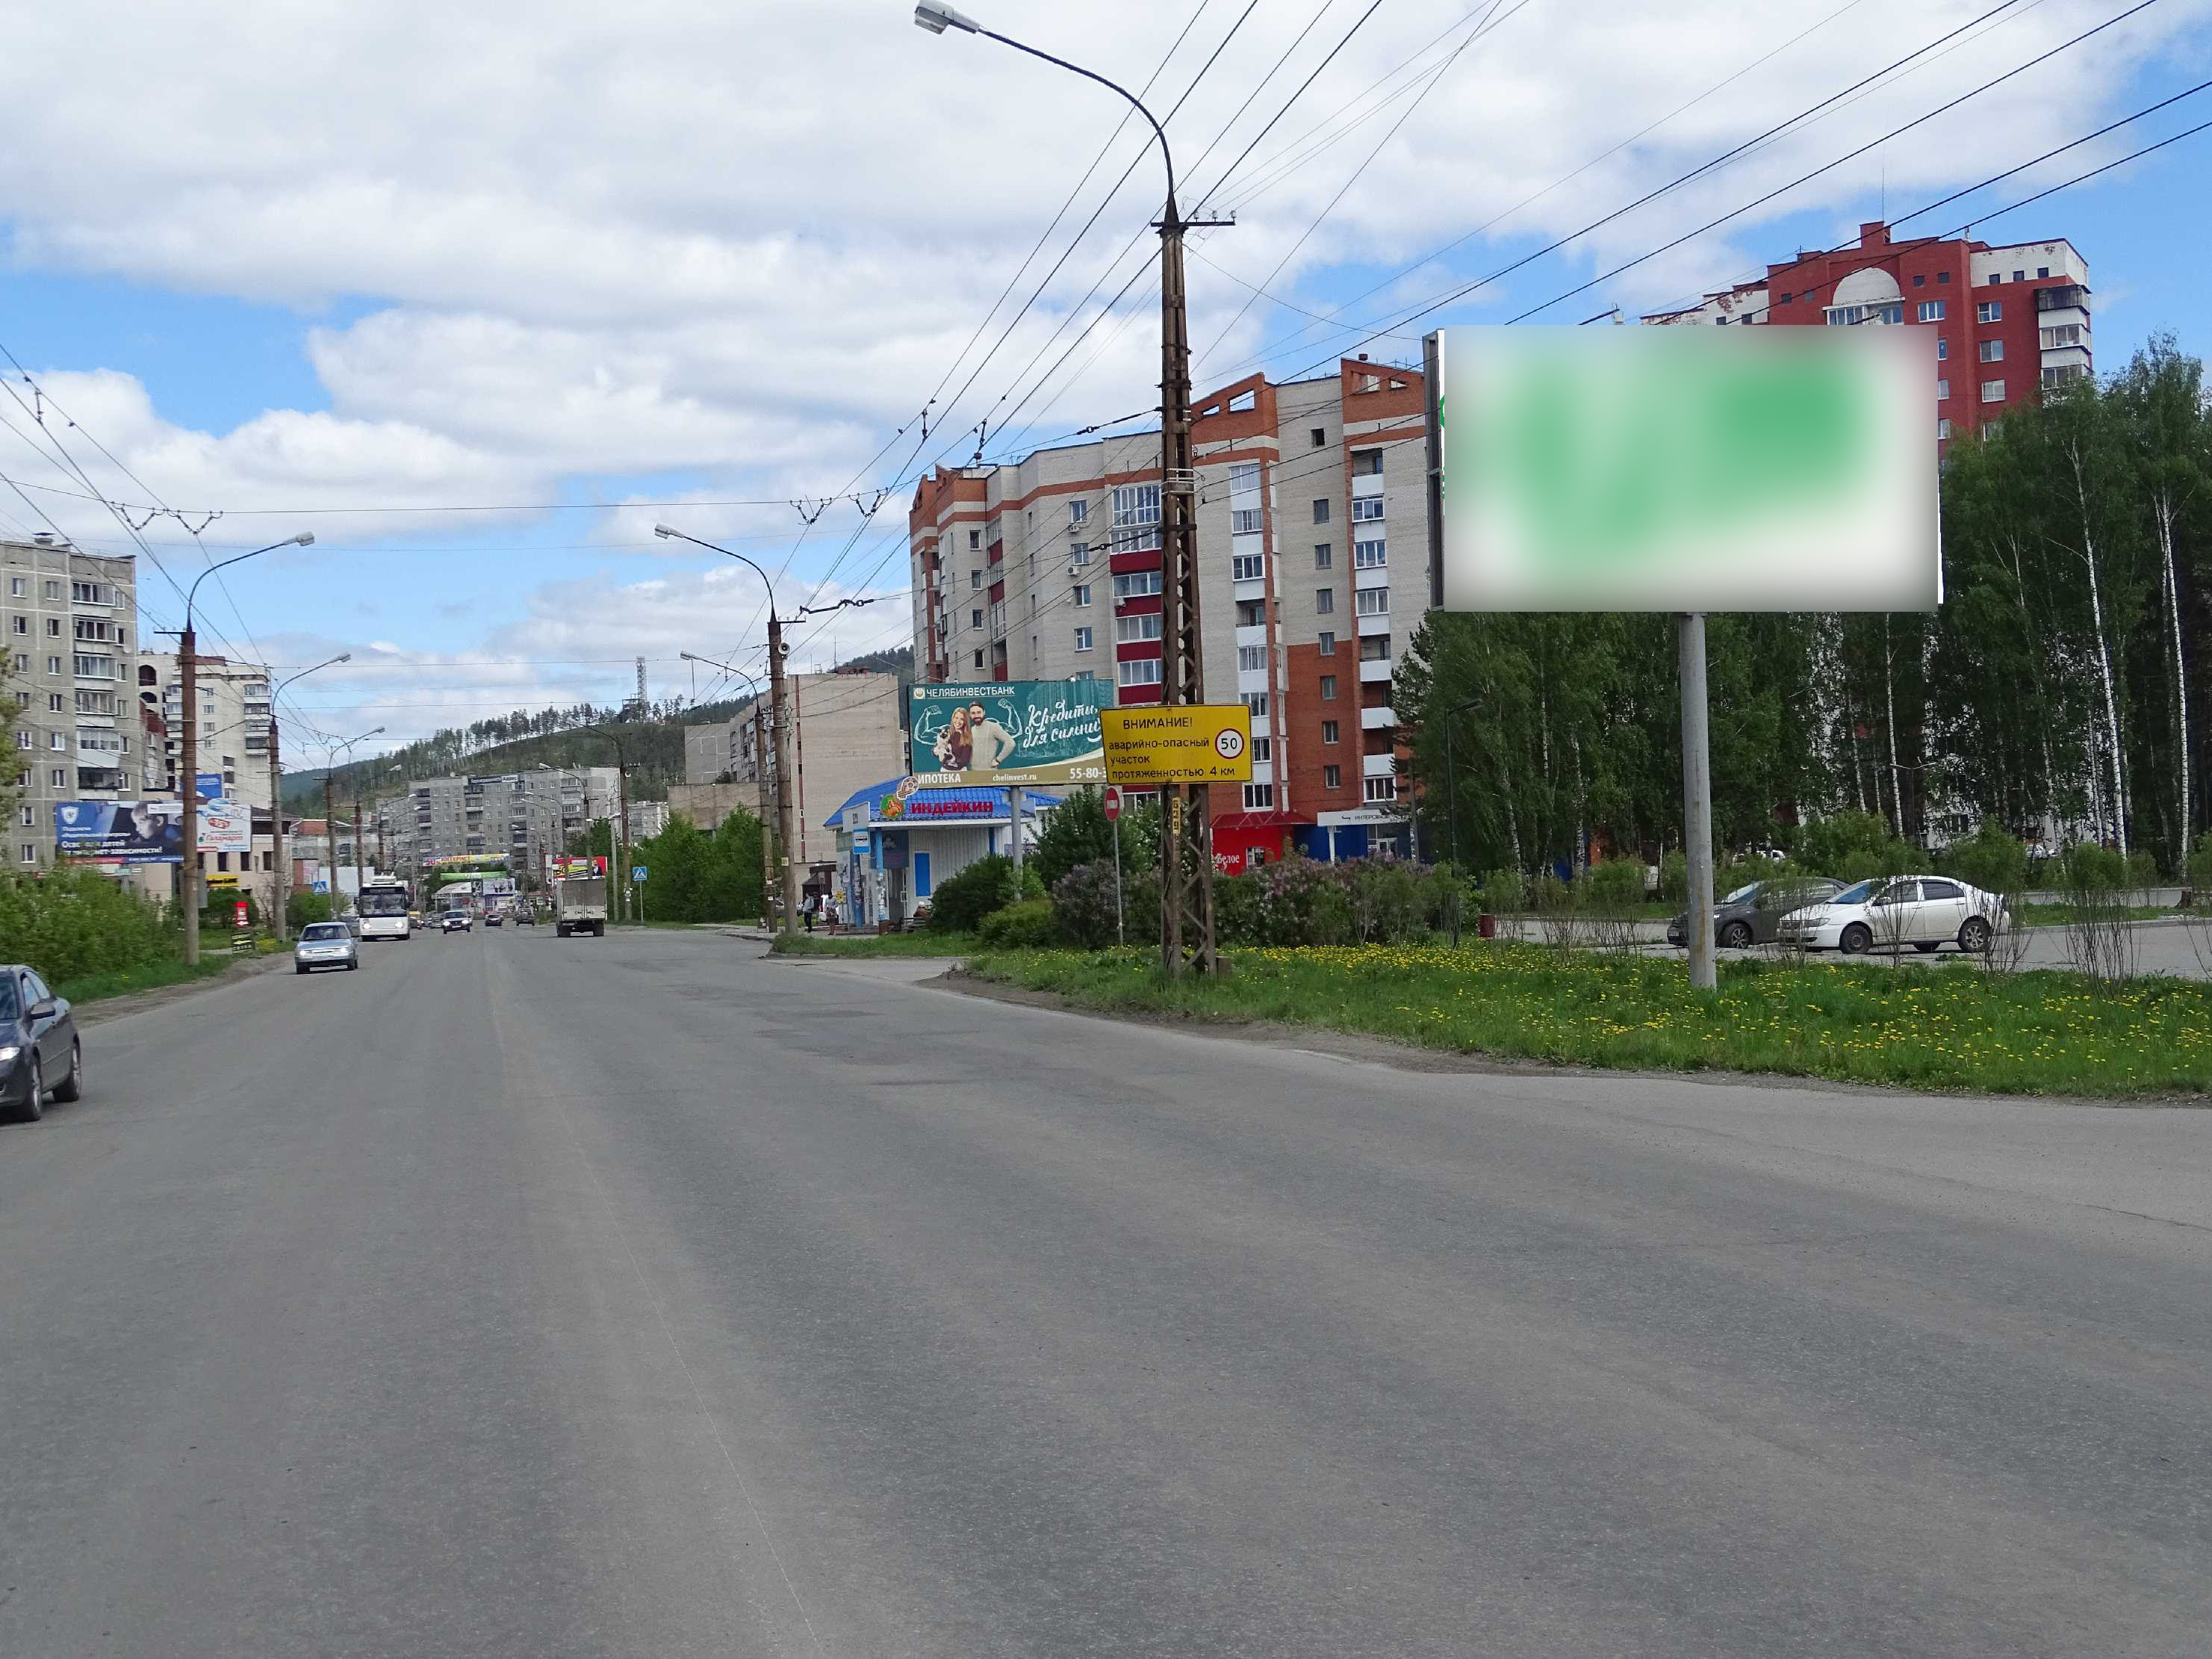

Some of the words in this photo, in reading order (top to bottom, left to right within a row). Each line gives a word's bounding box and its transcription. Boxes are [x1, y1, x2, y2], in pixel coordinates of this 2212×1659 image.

[926, 686, 1016, 697] ЧЕЛЯБИНВЕСТБАНК
[1122, 717, 1193, 730] ВНИМАНИЕ!
[1022, 725, 1048, 748] для
[1051, 718, 1103, 742] сильны
[1108, 737, 1210, 751] аварийно-опасный
[1220, 737, 1238, 750] 50
[1110, 754, 1151, 766] участок
[918, 773, 961, 784] ИПОТЕКА
[992, 773, 1037, 783] chelinvest.ru
[1112, 768, 1205, 781] протяженностью
[1209, 766, 1217, 776] 4
[1220, 768, 1235, 776] км
[910, 799, 994, 816] ИНДЕЙКИН
